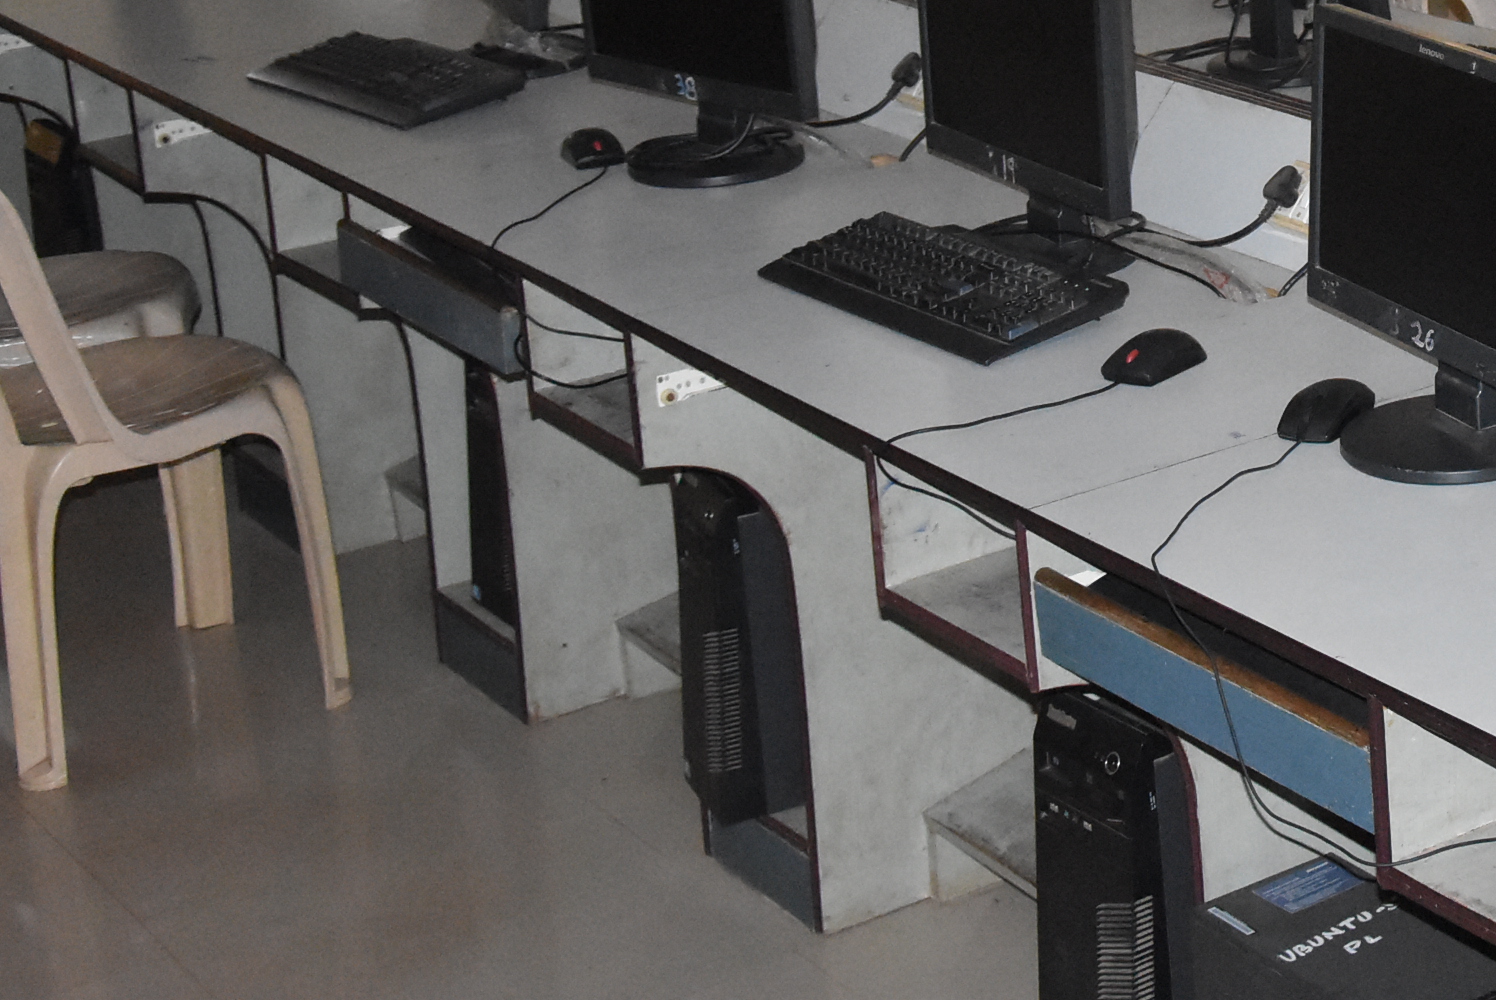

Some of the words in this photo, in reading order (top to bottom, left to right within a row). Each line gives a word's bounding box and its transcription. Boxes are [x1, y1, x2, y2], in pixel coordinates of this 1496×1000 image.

[1418, 43, 1445, 61] lenovo
[674, 73, 698, 101] 38
[1410, 320, 1435, 352] 26
